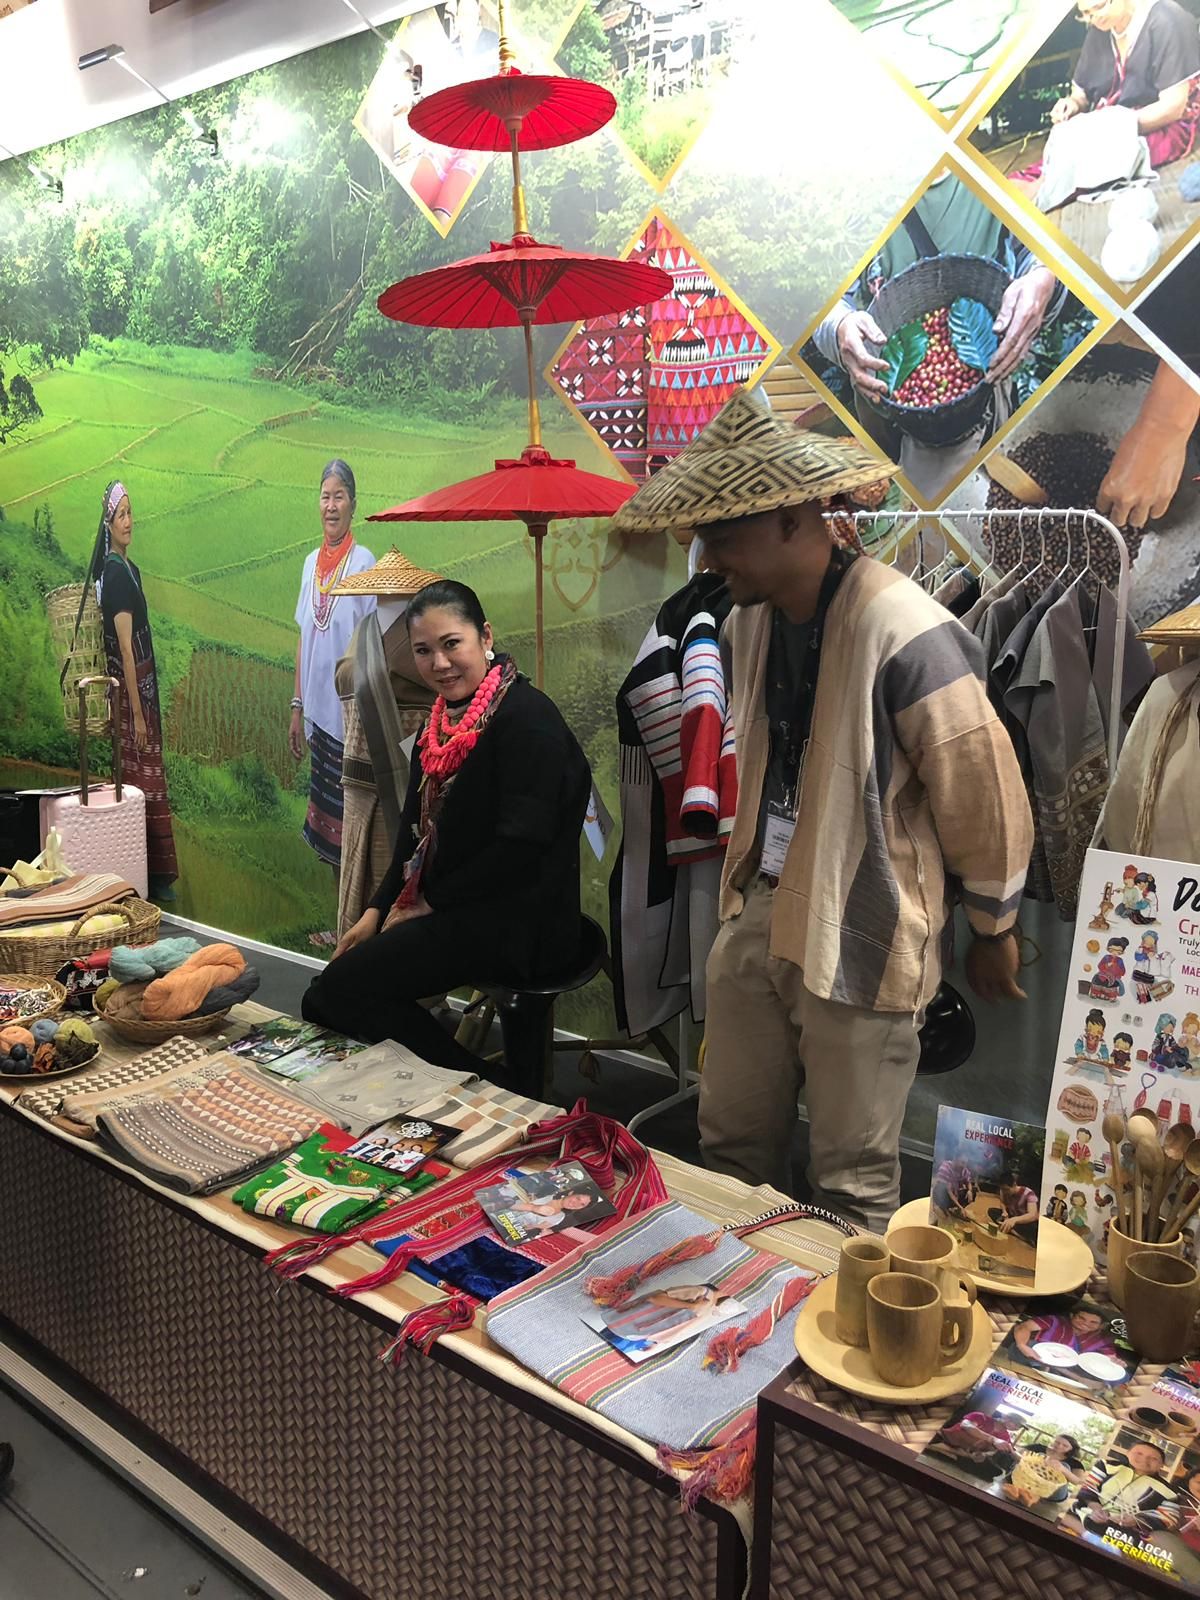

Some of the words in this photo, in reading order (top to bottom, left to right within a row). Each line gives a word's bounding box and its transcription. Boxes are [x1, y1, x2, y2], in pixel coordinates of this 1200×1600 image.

[1178, 918, 1200, 936] Cr
[1178, 937, 1200, 949] Truly
[989, 1124, 1013, 1138] LOCAL
[984, 1379, 1042, 1406] EXPERIENCE
[988, 1372, 1012, 1387] REAL
[1014, 1383, 1044, 1400] LOCAL
[1151, 1387, 1200, 1412] EXPERIEN
[1101, 1534, 1173, 1573] EXPERIENCE
[1105, 1526, 1134, 1546] REAL
[1137, 1540, 1174, 1562] LOCAL
